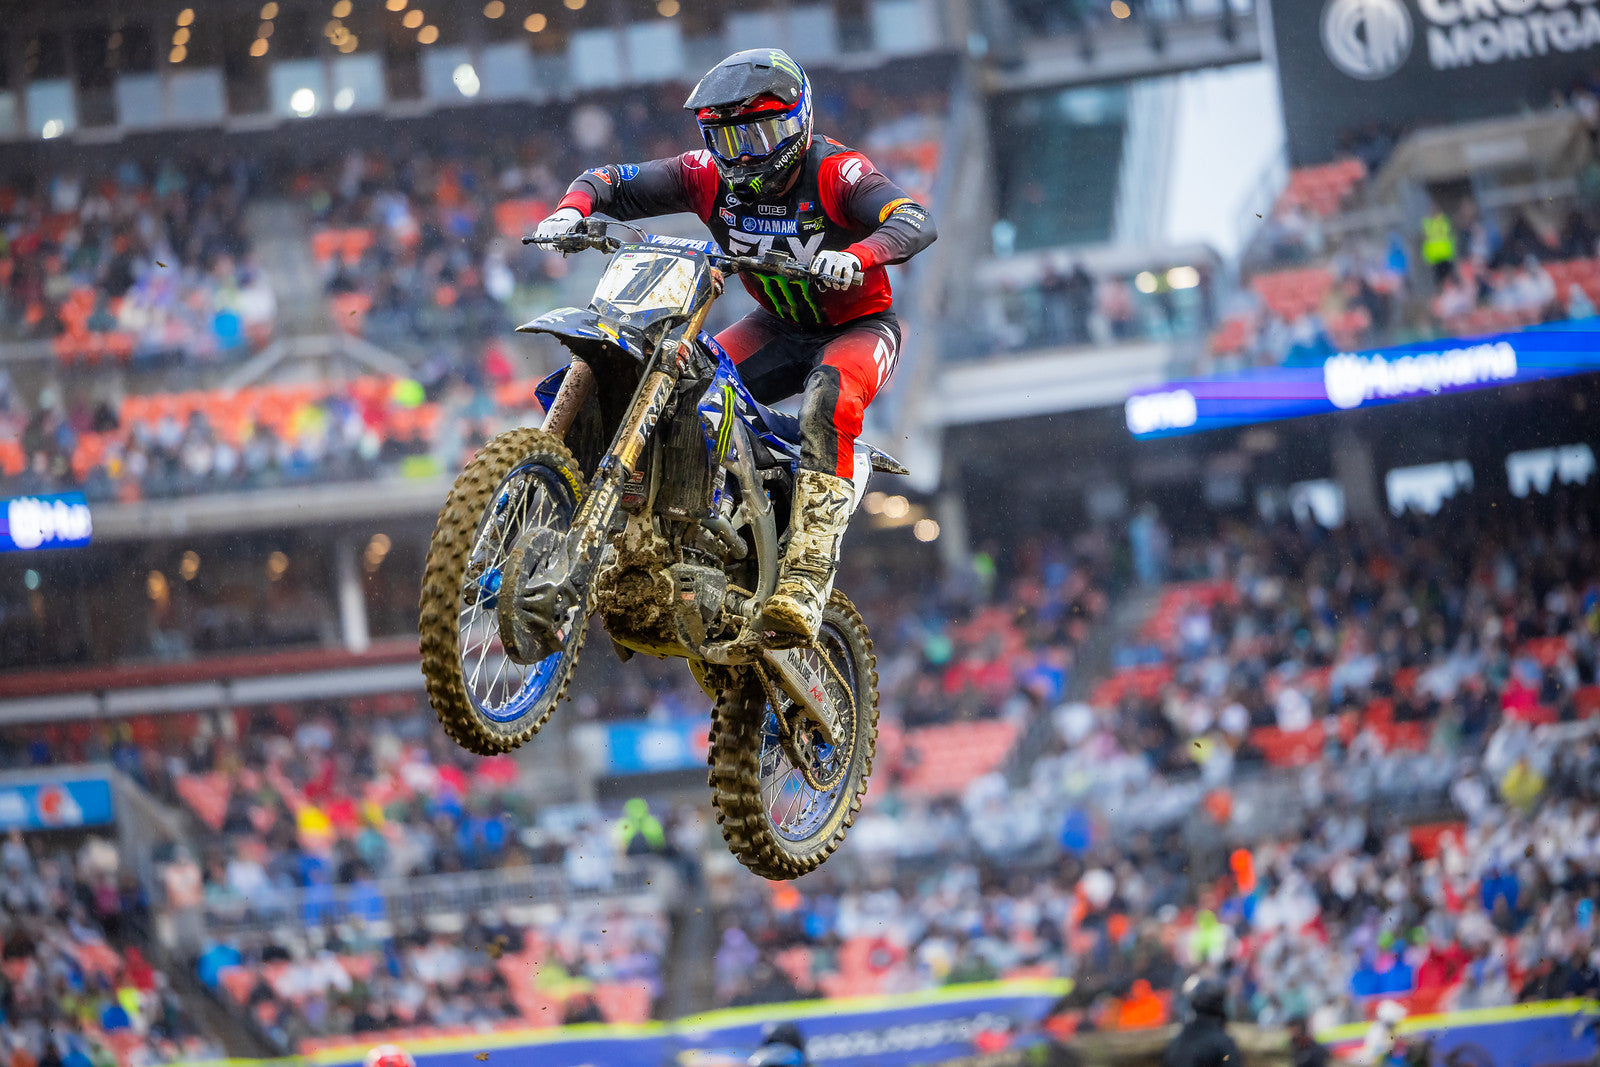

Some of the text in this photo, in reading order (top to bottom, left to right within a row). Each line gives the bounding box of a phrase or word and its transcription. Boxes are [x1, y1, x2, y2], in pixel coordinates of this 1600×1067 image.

[757, 204, 787, 216] WPS
[757, 219, 798, 234] YAMAHA
[609, 256, 679, 305] 1
[560, 466, 584, 504] DUNLO
